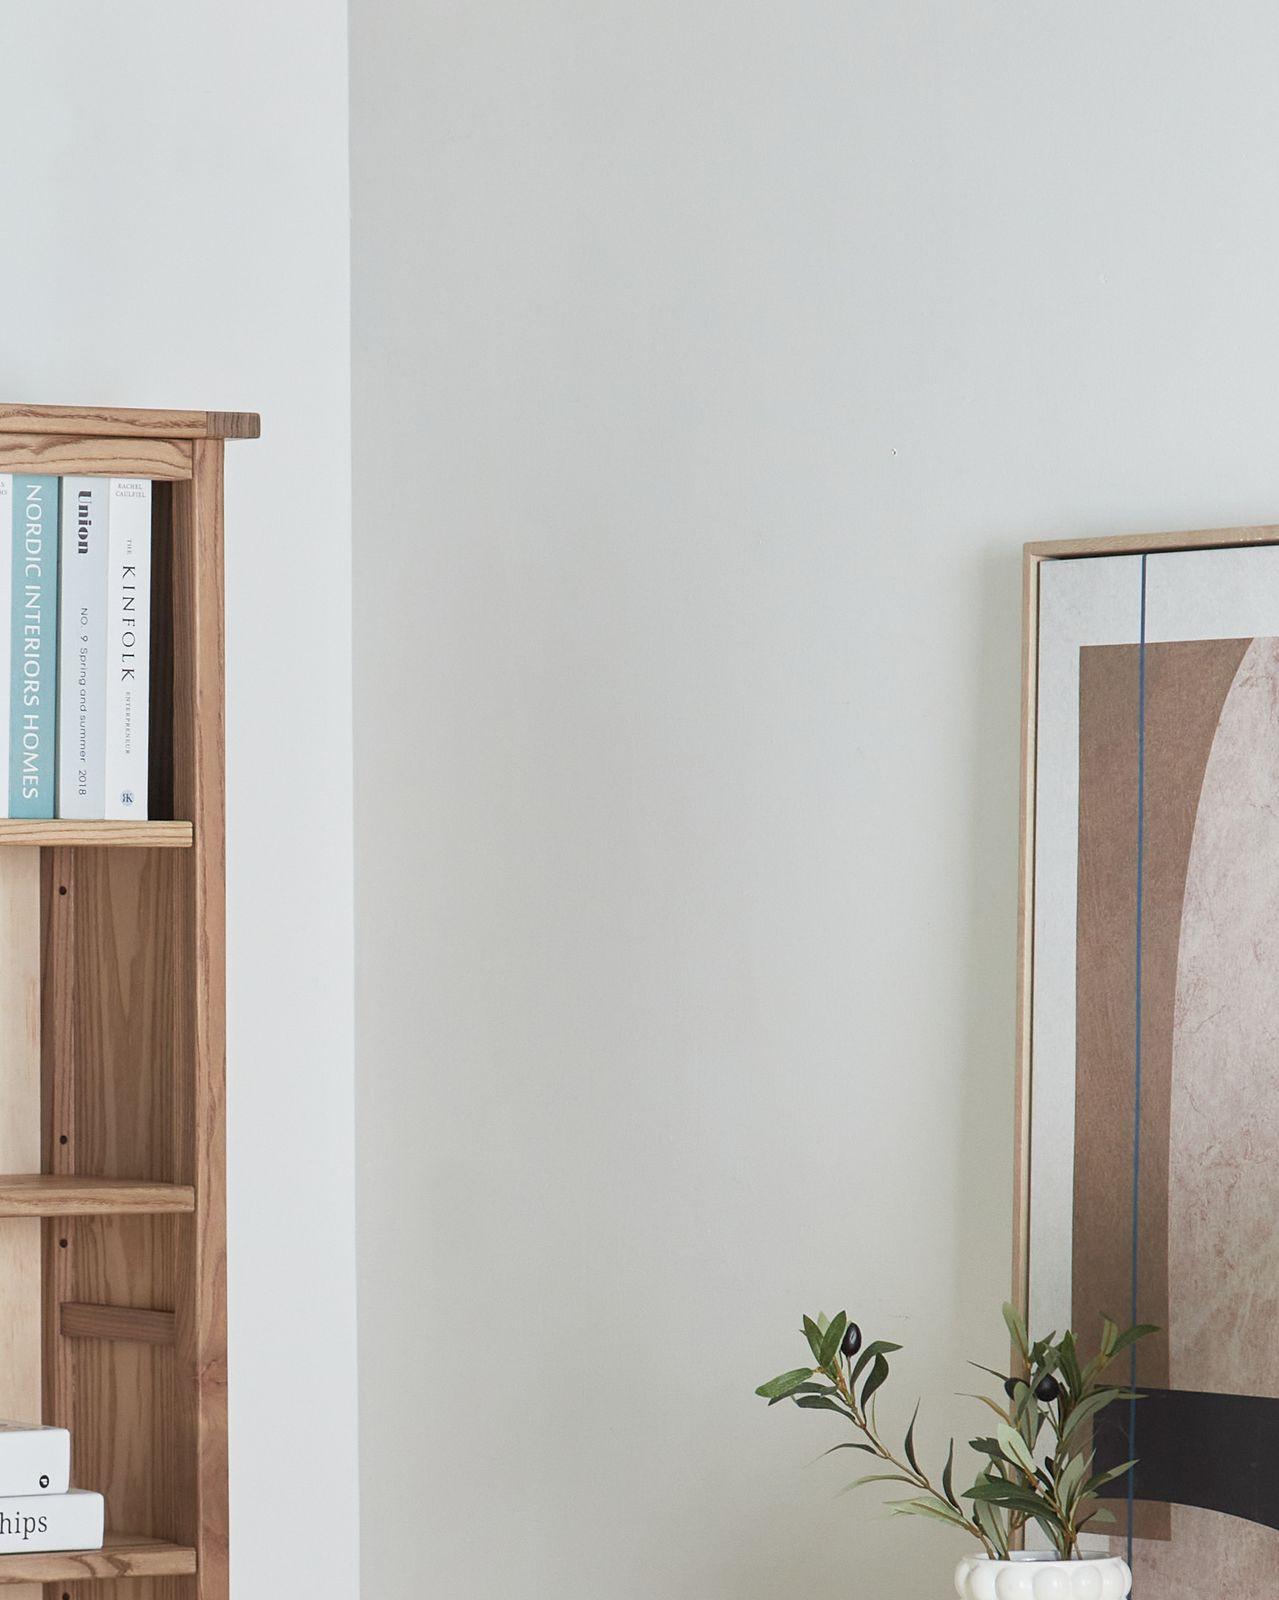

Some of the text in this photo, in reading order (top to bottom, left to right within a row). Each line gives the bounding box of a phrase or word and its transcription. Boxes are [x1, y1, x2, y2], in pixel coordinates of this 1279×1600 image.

[78, 490, 92, 554] Union
[22, 484, 42, 799] NORDIC INTERIORS HOMES
[121, 566, 136, 681] KINFOLK
[78, 647, 88, 686] Spring
[78, 769, 87, 796] 2018
